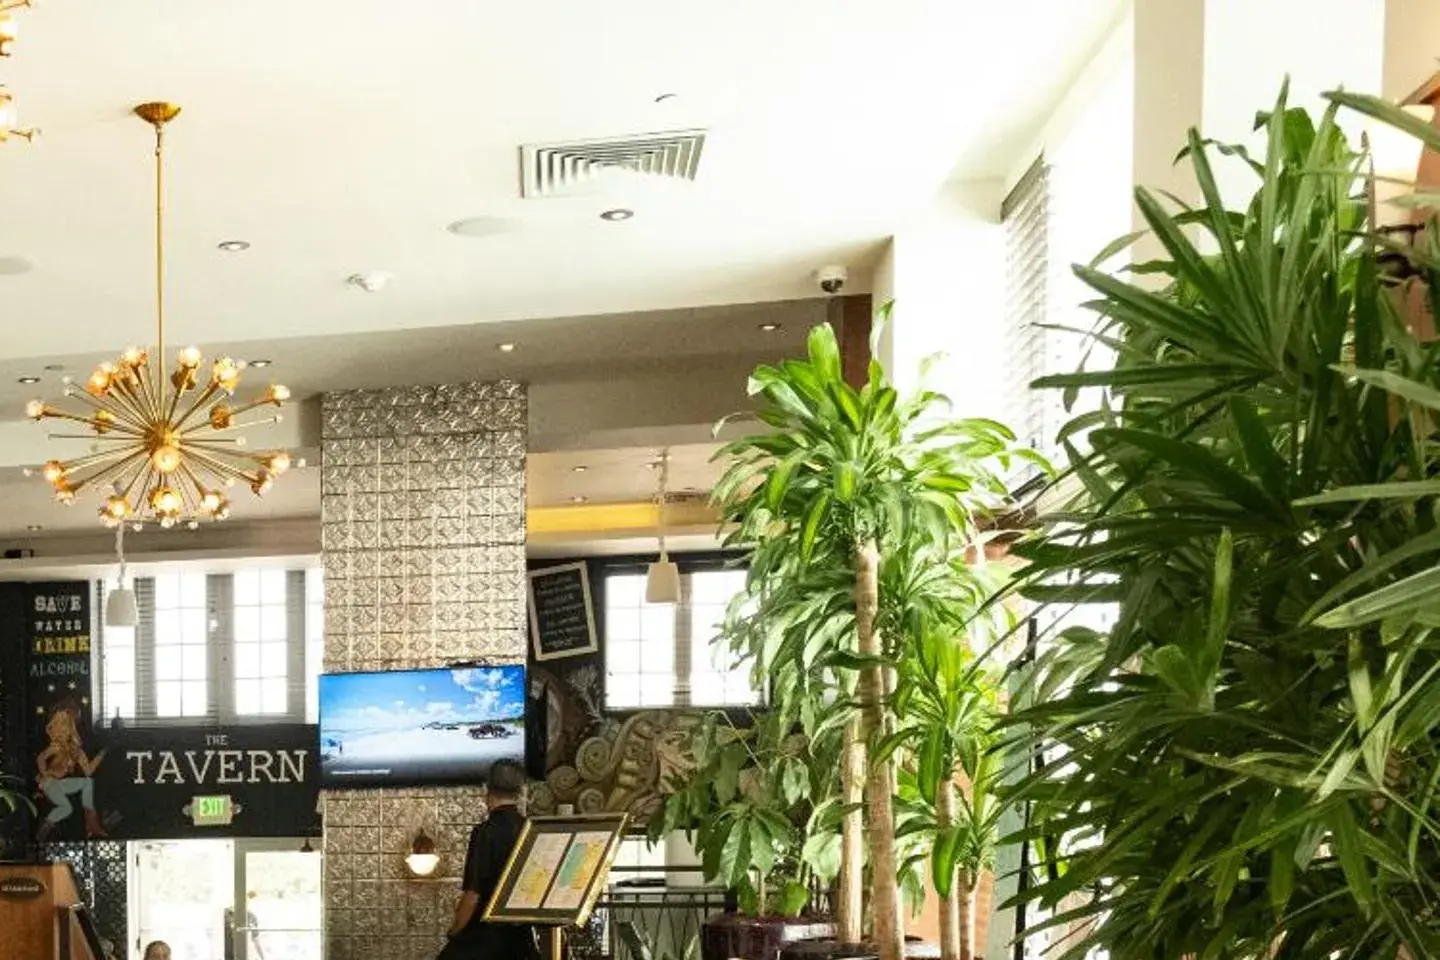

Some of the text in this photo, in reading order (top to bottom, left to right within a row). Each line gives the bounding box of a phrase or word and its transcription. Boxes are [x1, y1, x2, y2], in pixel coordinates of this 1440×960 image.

[34, 595, 82, 613] SAVE
[34, 620, 82, 631] WATER
[30, 661, 90, 677] ALCOHOL
[205, 734, 228, 747] THE
[126, 750, 308, 785] TAVERN
[199, 797, 225, 816] EXIT
